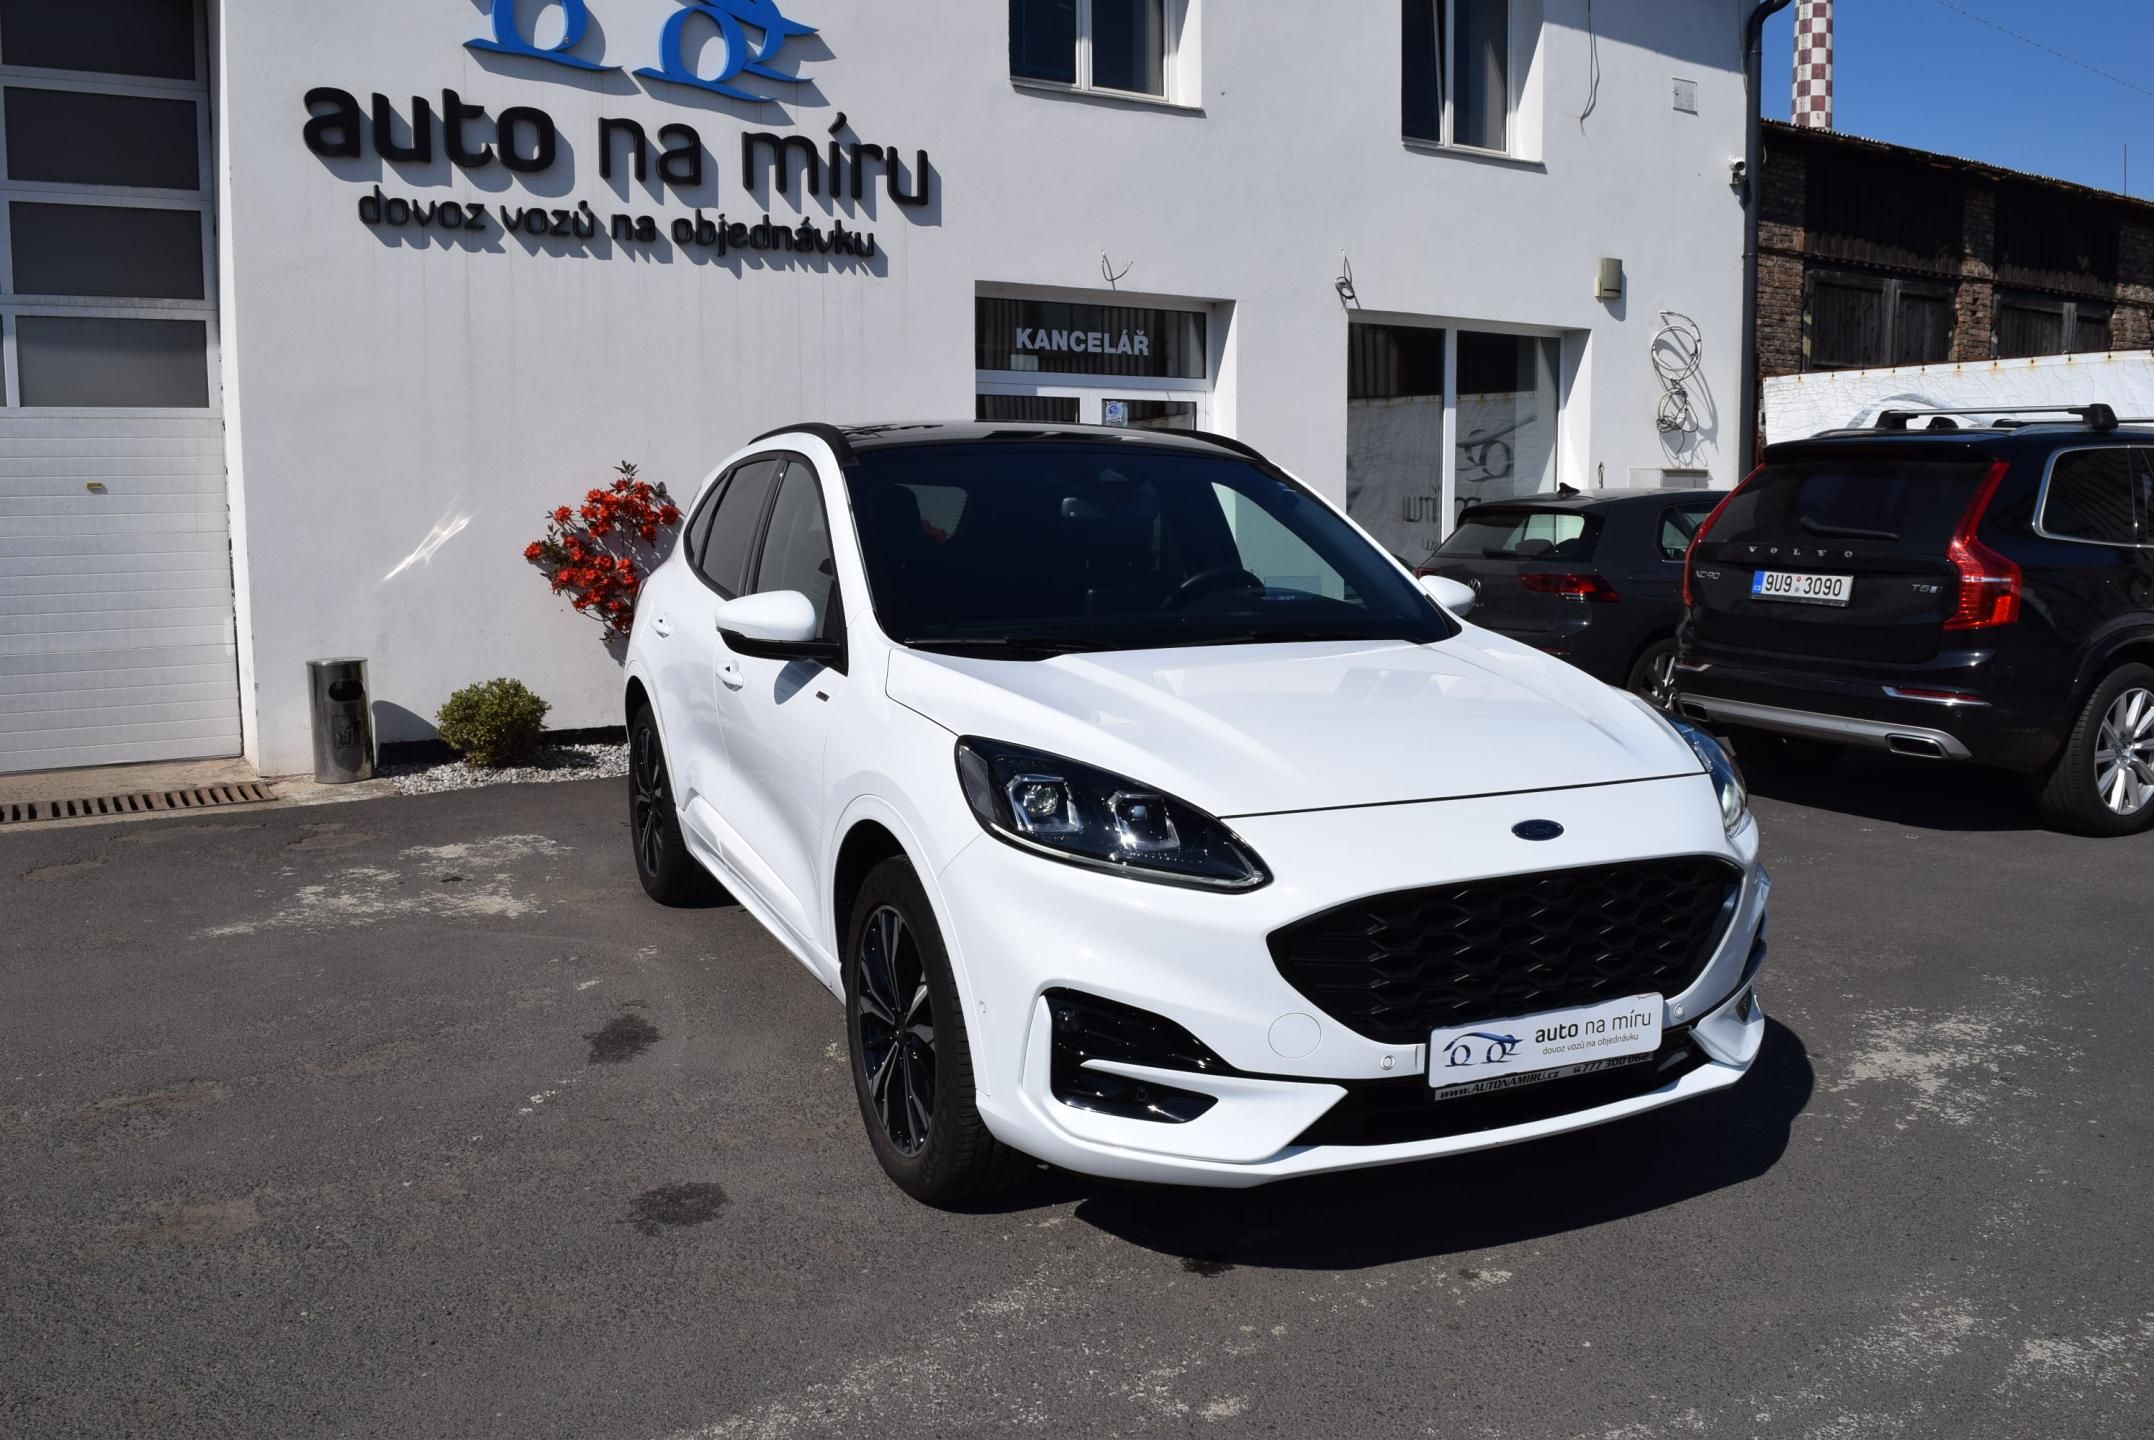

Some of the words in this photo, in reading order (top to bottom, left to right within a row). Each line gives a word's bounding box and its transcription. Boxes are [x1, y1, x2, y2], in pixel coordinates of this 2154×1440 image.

[302, 86, 556, 174] auto
[599, 115, 703, 187] na
[741, 111, 929, 207] míru
[358, 185, 487, 231] dovoz
[500, 200, 595, 239] vozů
[611, 213, 656, 242] na
[671, 208, 875, 258] objednávku
[1016, 327, 1149, 356] KANCELÁŘ
[1749, 546, 1853, 558] VOLVO
[1765, 574, 1793, 593] 9U9
[1803, 577, 1843, 597] 3090
[1535, 1023, 1579, 1044] auto
[1585, 1019, 1606, 1036] na
[1612, 1009, 1651, 1031] míru
[1542, 1045, 1566, 1056] dovoz
[1567, 1040, 1585, 1051] vozů
[1586, 1039, 1596, 1048] na
[1597, 1033, 1639, 1047] objednávku
